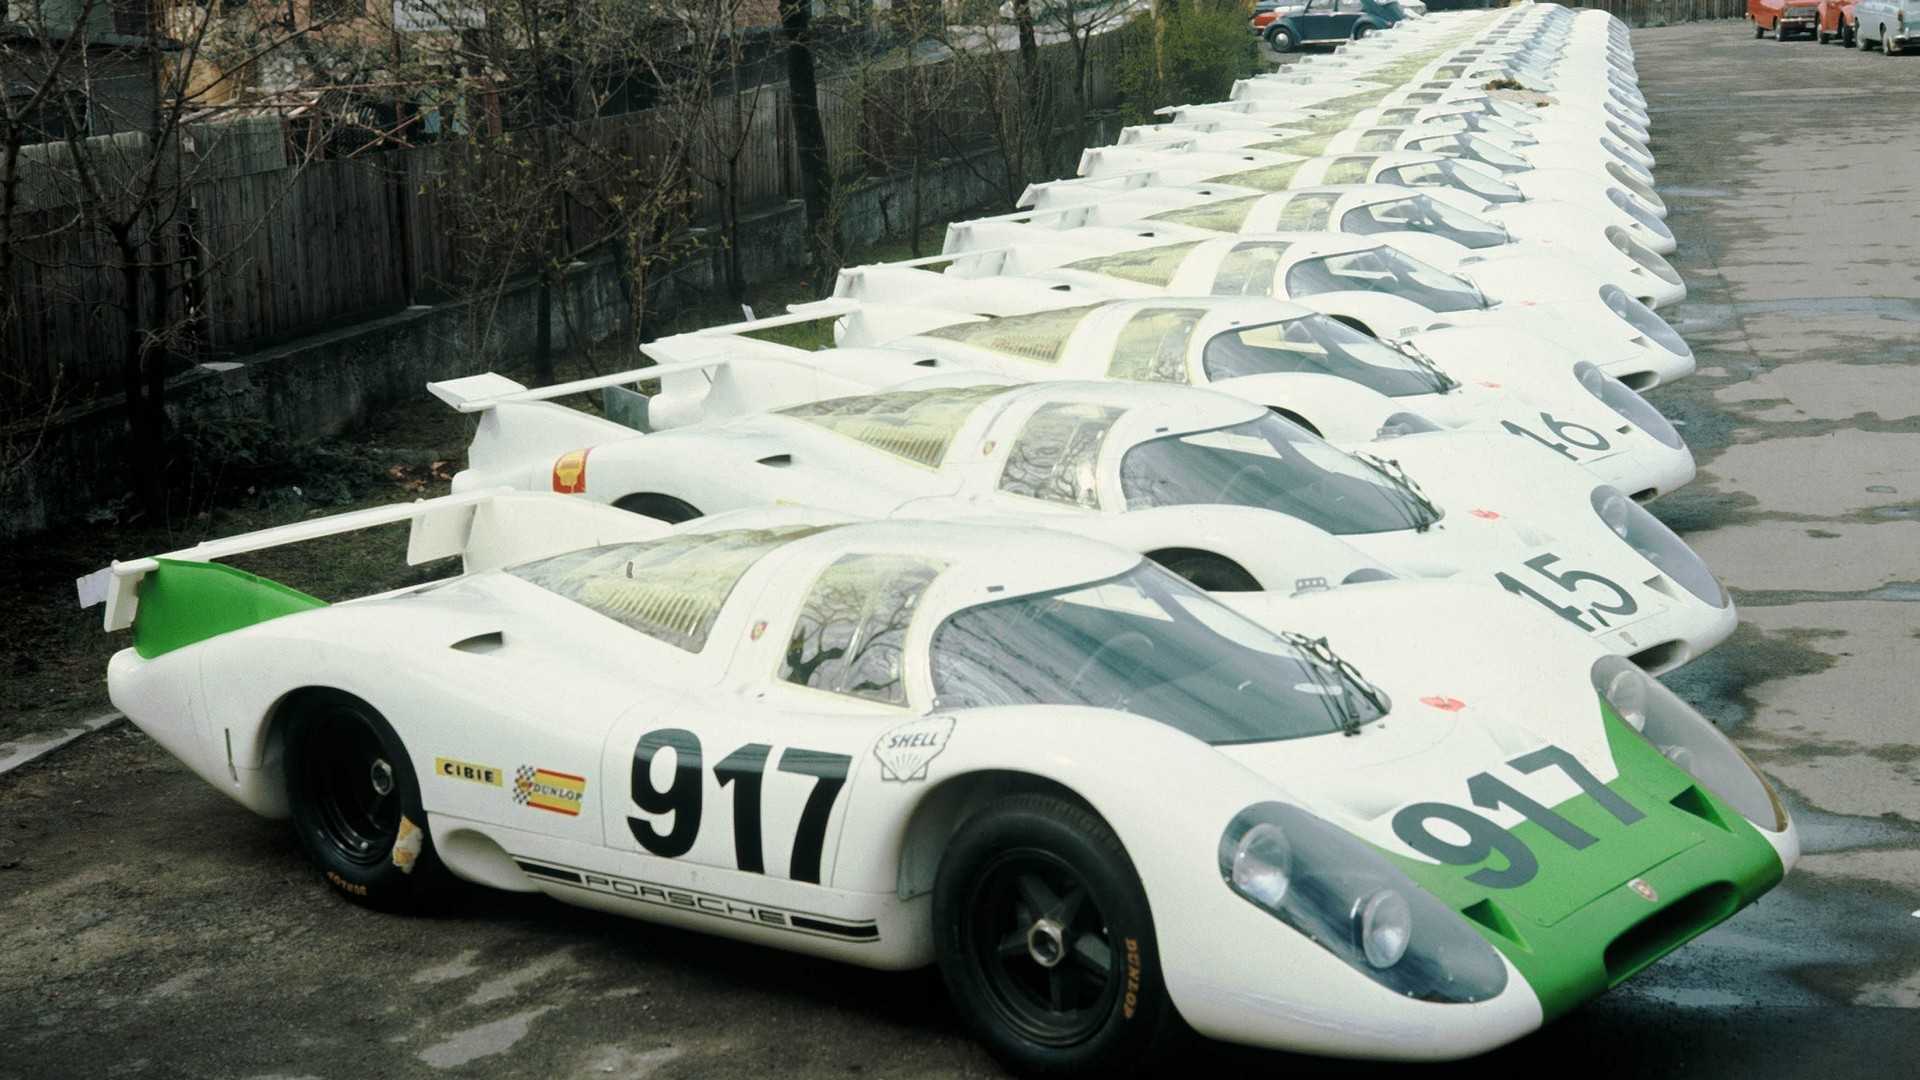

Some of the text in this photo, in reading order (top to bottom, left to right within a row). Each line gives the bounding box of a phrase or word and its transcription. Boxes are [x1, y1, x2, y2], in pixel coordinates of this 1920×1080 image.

[1500, 412, 1611, 462] 16
[1494, 552, 1638, 633] 15
[888, 732, 938, 749] SHELL
[444, 763, 494, 783] CIBIE
[533, 783, 583, 801] DUNLOP
[626, 728, 853, 885] 917
[1391, 744, 1647, 890] 917
[586, 875, 786, 925] PORSCHE
[1123, 938, 1140, 1019] DUNLOP
